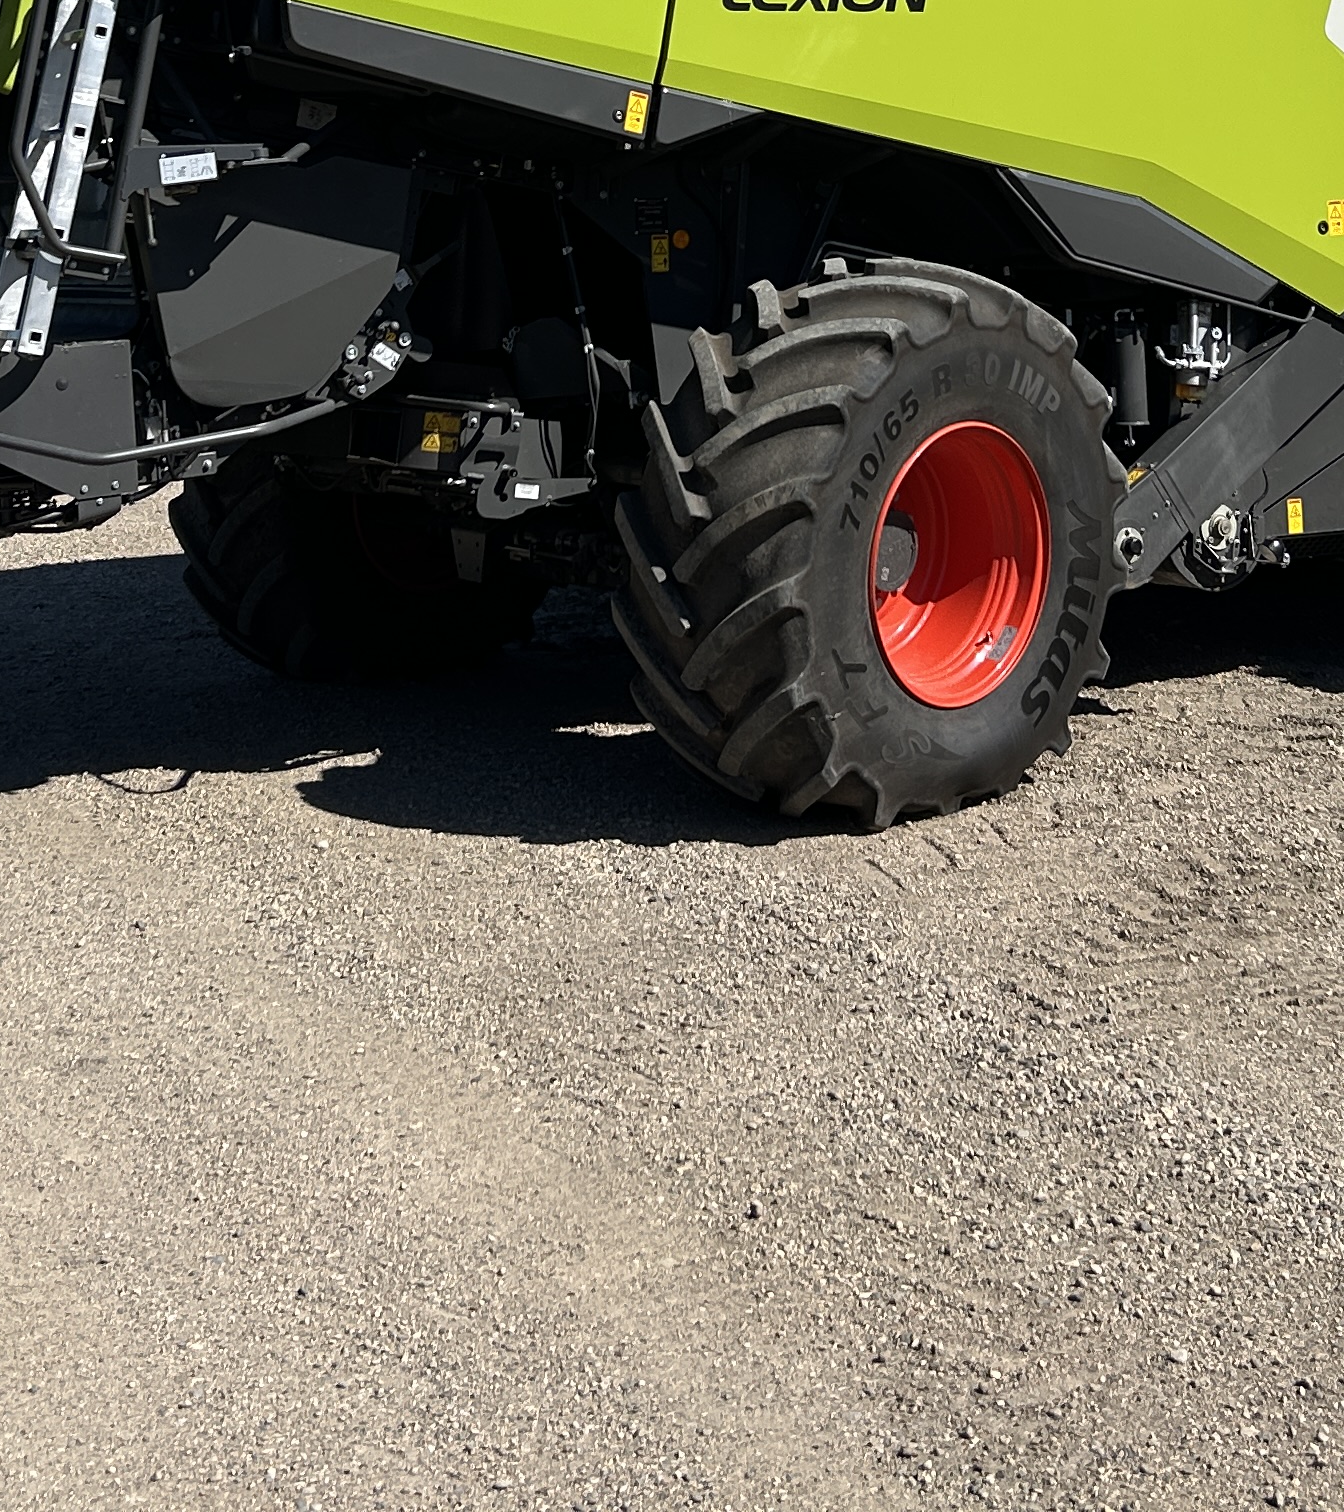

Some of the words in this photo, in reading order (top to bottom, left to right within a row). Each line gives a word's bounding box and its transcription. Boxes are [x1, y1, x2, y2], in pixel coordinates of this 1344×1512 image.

[839, 389, 920, 530] 710/65
[1008, 359, 1061, 415] IMP
[1021, 499, 1103, 729] Mitas
